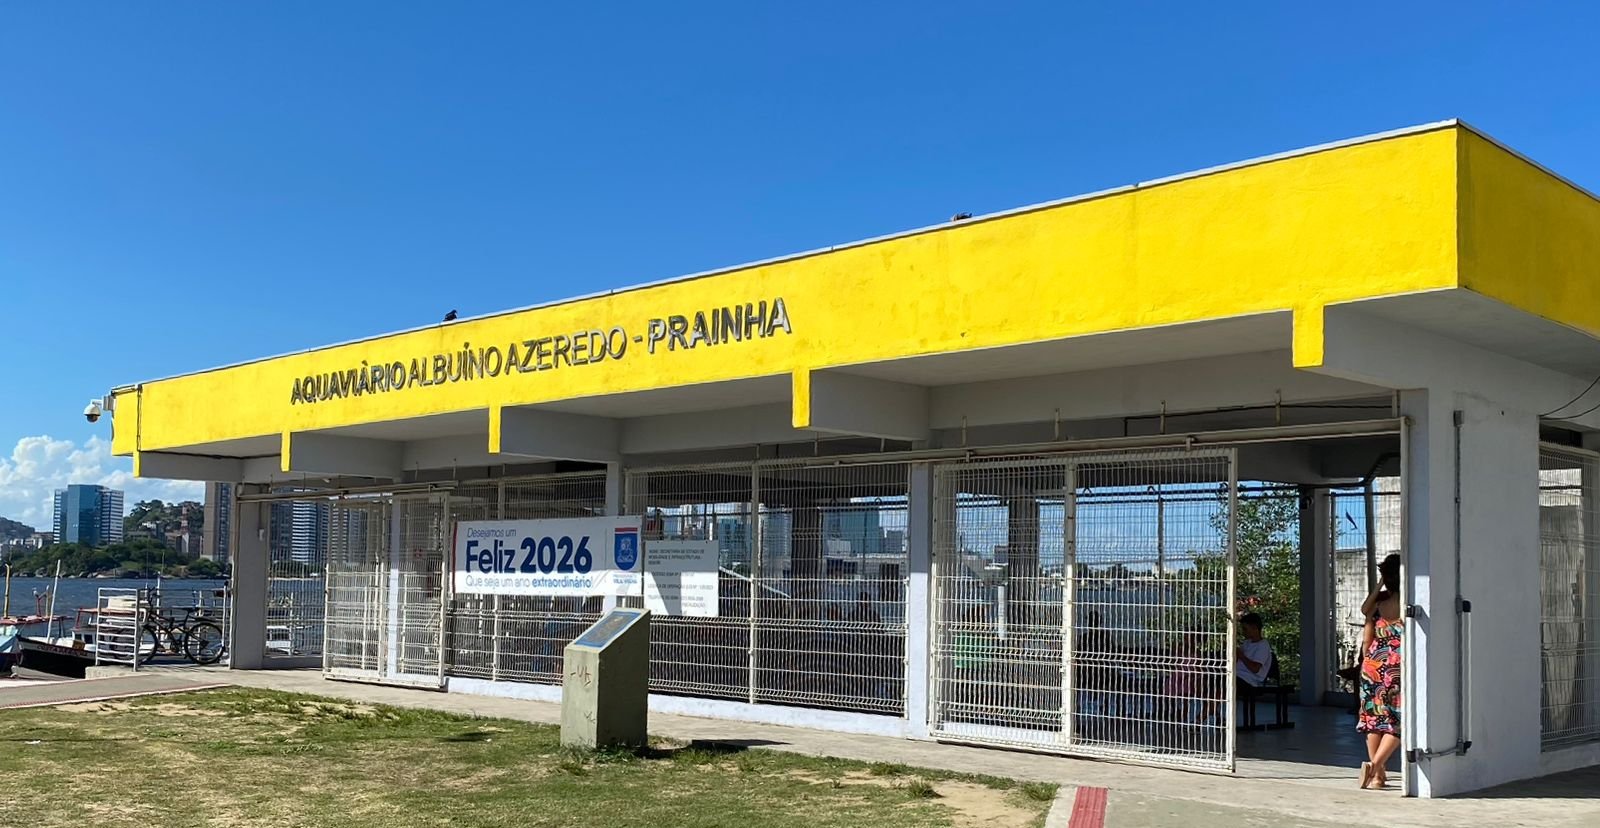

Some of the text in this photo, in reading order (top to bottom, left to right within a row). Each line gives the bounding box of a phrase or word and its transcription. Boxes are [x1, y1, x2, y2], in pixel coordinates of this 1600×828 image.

[408, 342, 503, 388] ALBUÍNO
[504, 326, 627, 375] AZEREDO
[647, 297, 792, 354] PRAINHA
[467, 527, 517, 540] Desejamos um
[466, 535, 593, 574] Feliz 2026
[466, 574, 482, 587] Que
[484, 577, 500, 590] seja
[501, 578, 514, 588] um
[514, 577, 531, 588] ano
